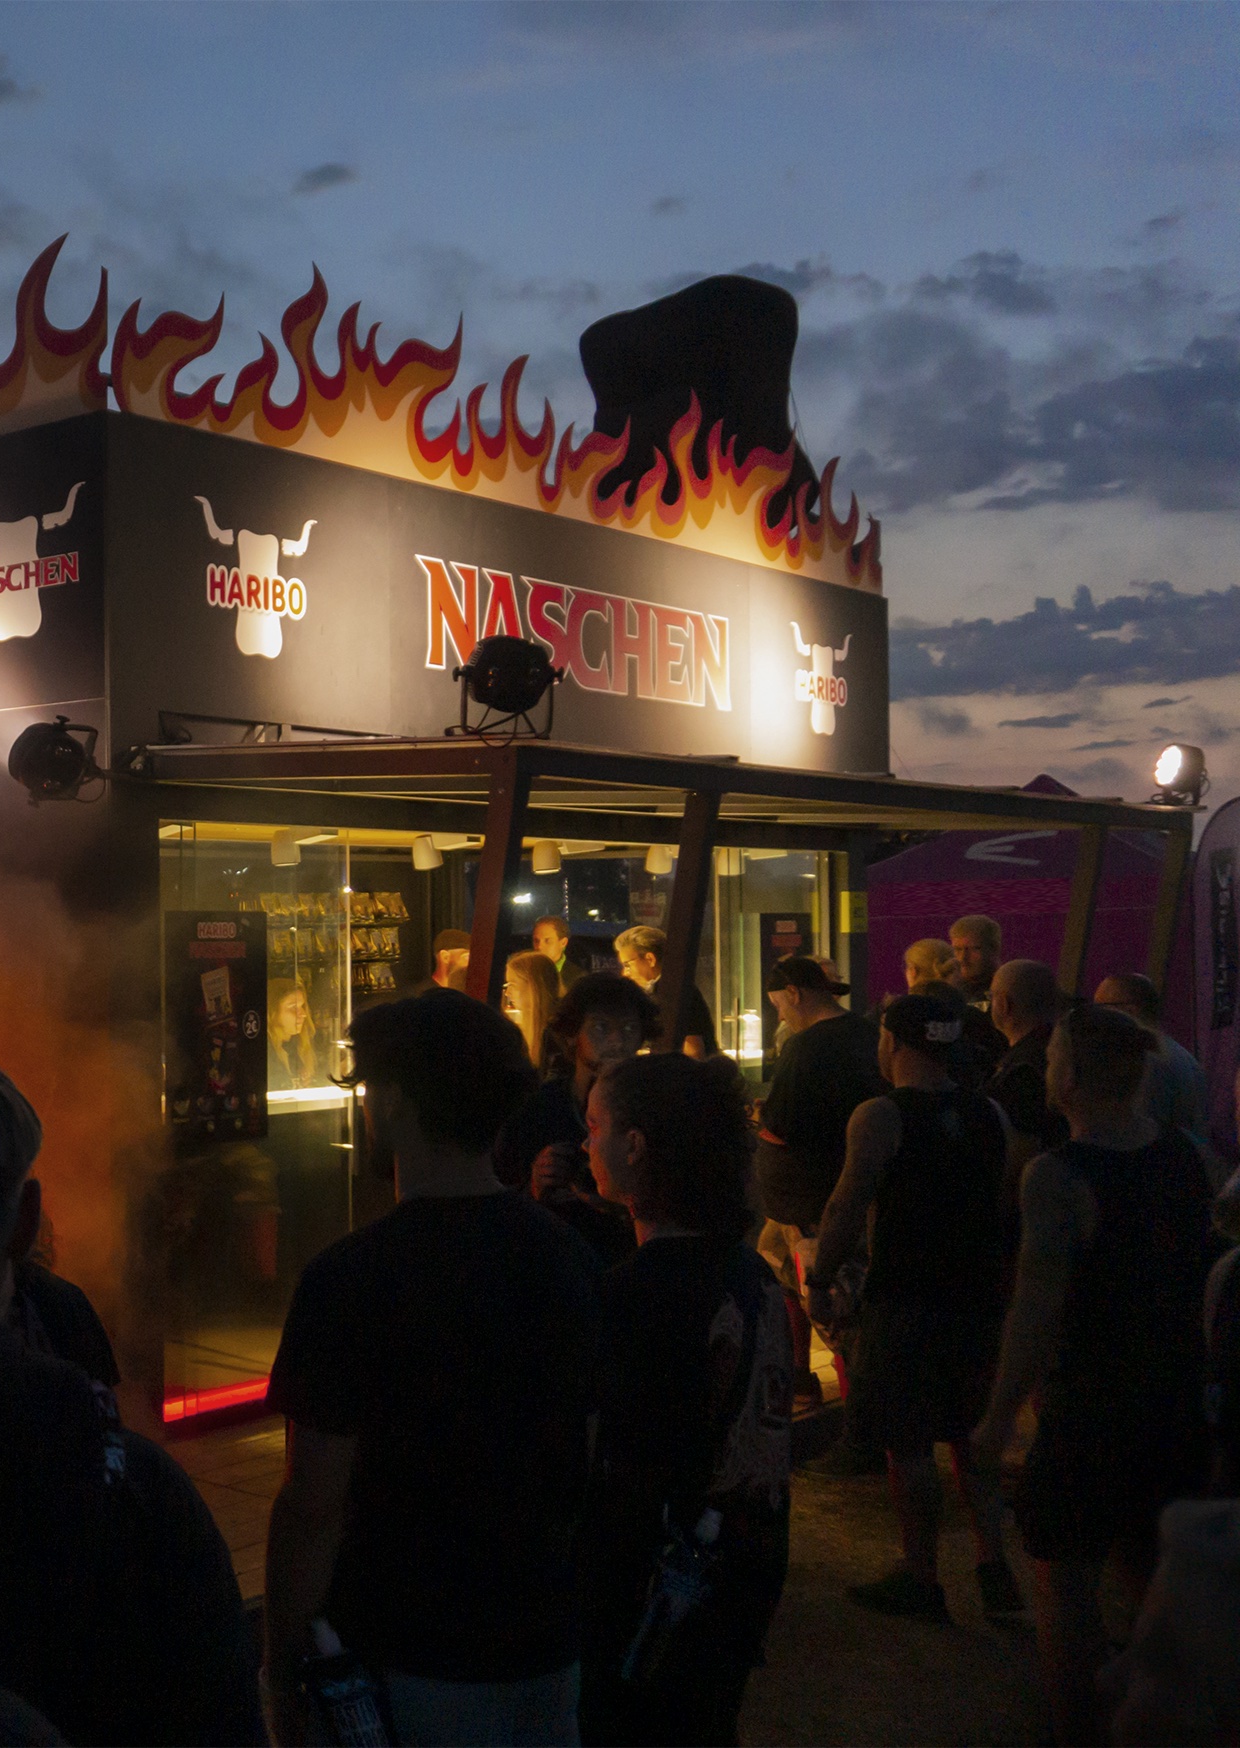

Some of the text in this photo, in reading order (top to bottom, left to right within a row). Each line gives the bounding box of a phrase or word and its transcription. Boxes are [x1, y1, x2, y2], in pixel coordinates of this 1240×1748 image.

[207, 563, 307, 620] HARIBO
[414, 554, 732, 711] NASCHEN
[795, 668, 847, 707] ARIBO
[197, 921, 237, 939] HARIBO
